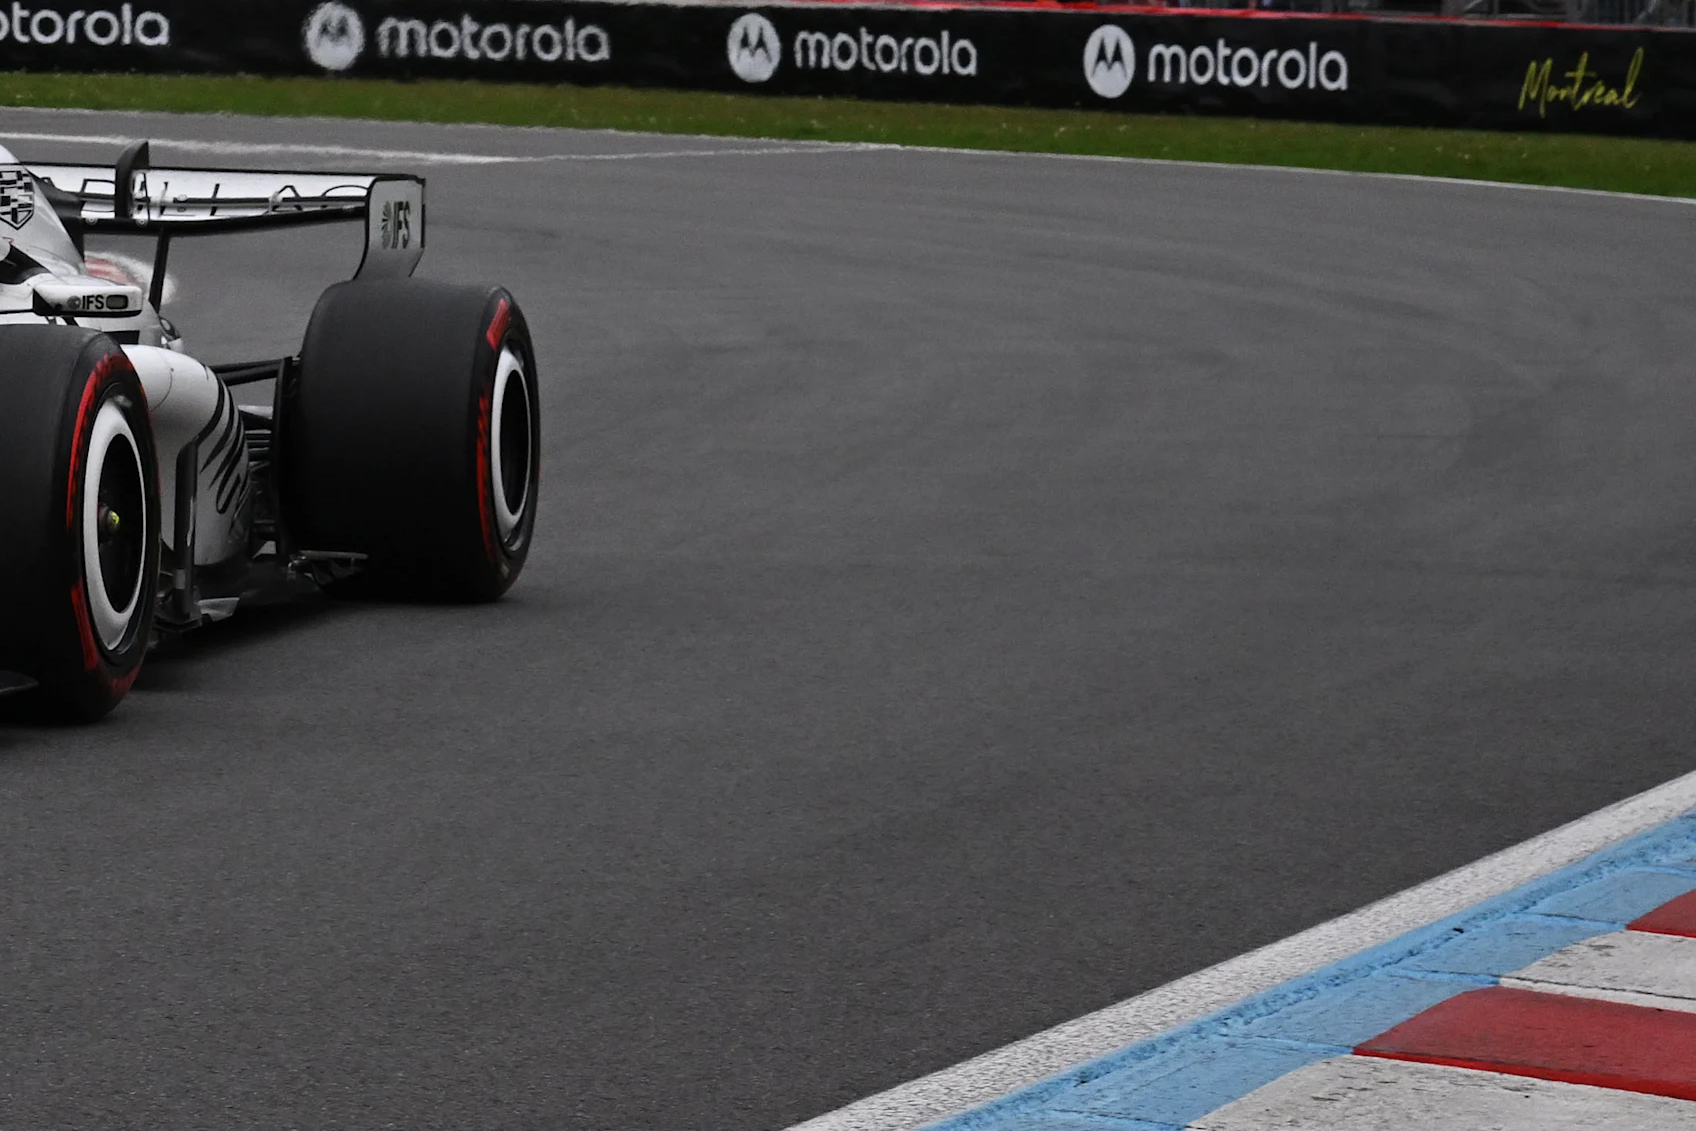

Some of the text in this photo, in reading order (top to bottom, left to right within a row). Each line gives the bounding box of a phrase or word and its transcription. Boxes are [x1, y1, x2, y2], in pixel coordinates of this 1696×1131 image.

[378, 15, 610, 62] motorola
[795, 27, 977, 75] motorola
[1148, 39, 1348, 91] motorola
[1518, 47, 1643, 118] Montreal
[81, 294, 105, 310] IFS
